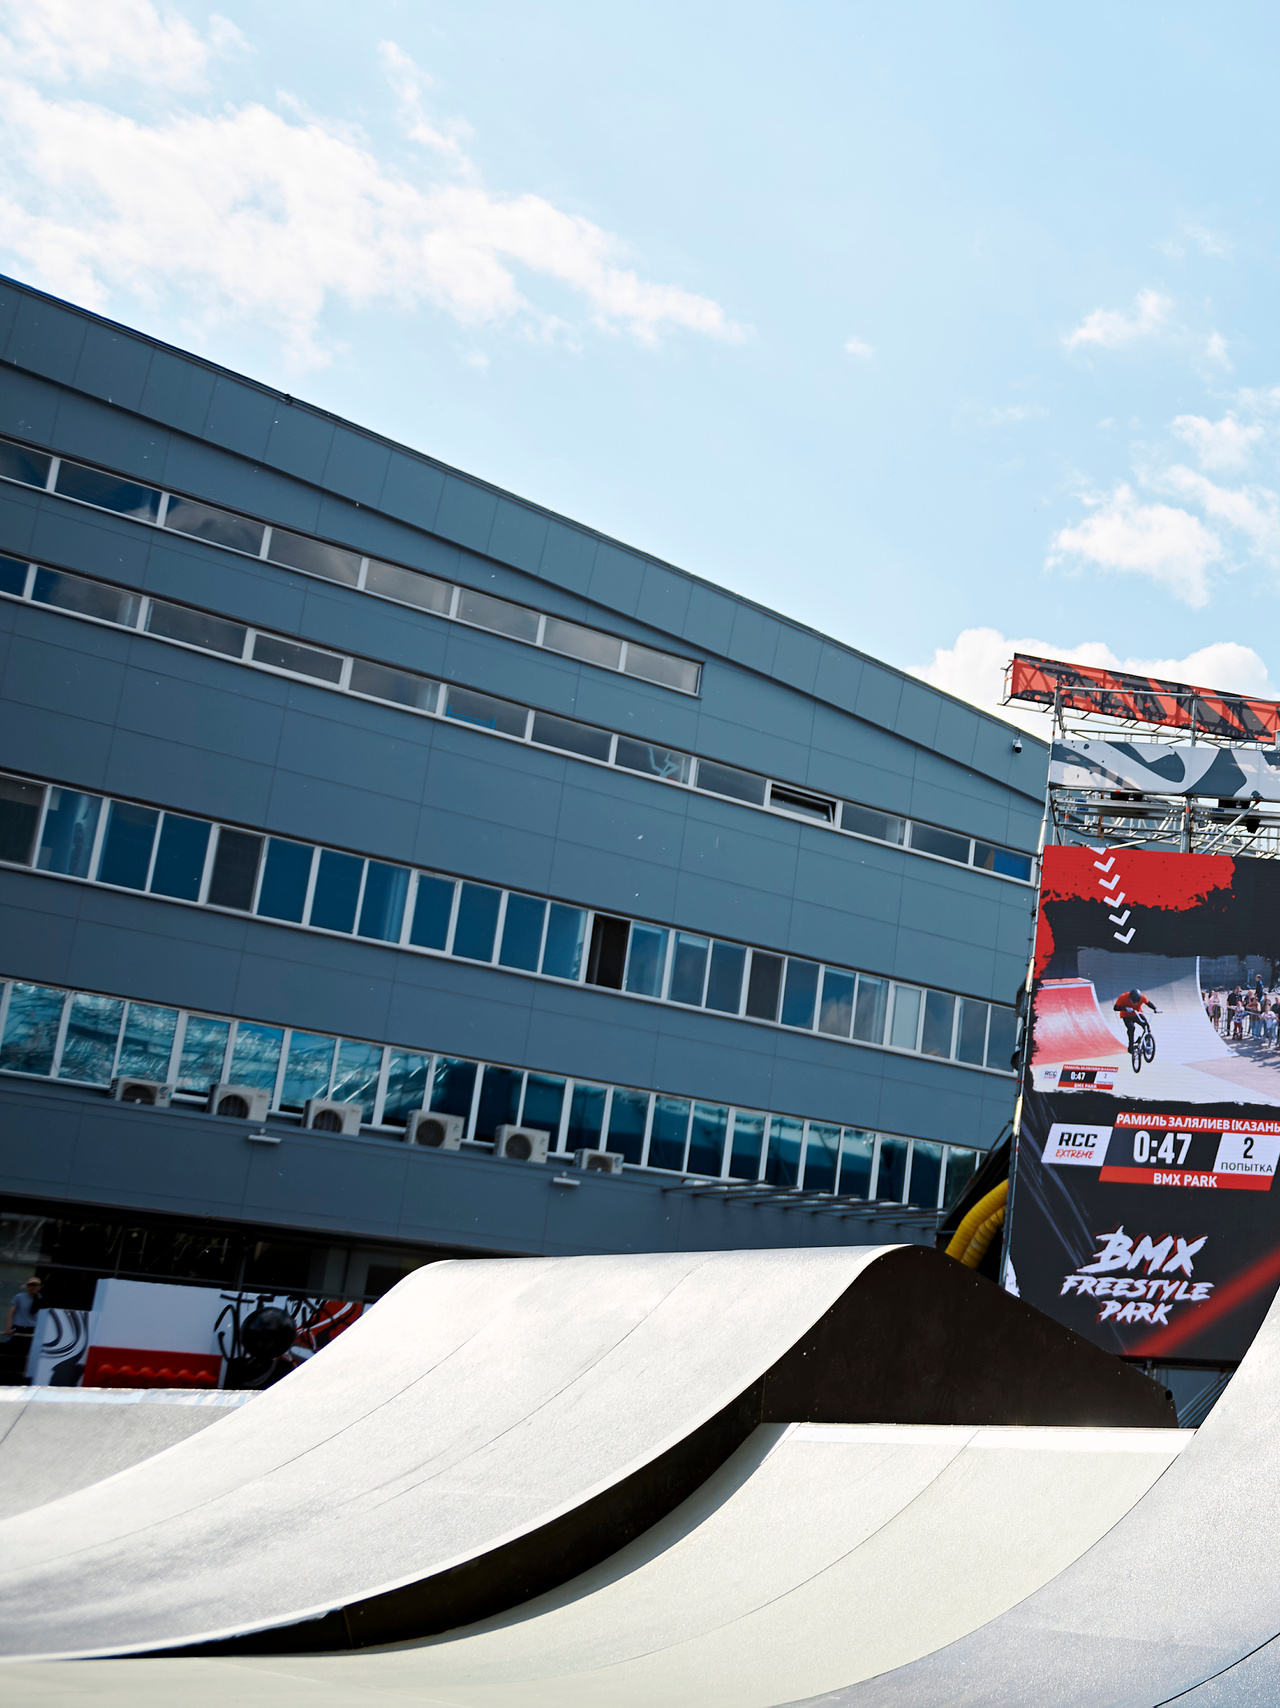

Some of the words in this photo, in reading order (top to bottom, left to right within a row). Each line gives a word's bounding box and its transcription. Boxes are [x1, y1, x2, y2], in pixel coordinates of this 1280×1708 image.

[1070, 1071, 1086, 1081] 0:47
[1116, 1114, 1167, 1127] РАМИЛЬ
[1168, 1116, 1231, 1130] ЗАЛЯЛИЕВ
[1058, 1132, 1098, 1148] RCC
[1133, 1130, 1192, 1165] 0:47
[1243, 1137, 1254, 1159] 2
[1055, 1149, 1094, 1159] EXTREME
[1221, 1162, 1273, 1173] ПОПЫТКА
[1153, 1172, 1181, 1186] BMX
[1184, 1175, 1218, 1188] PARK
[1076, 1225, 1209, 1277] BMX
[1060, 1274, 1215, 1301] FREESTYLE
[1098, 1300, 1174, 1325] PARK
